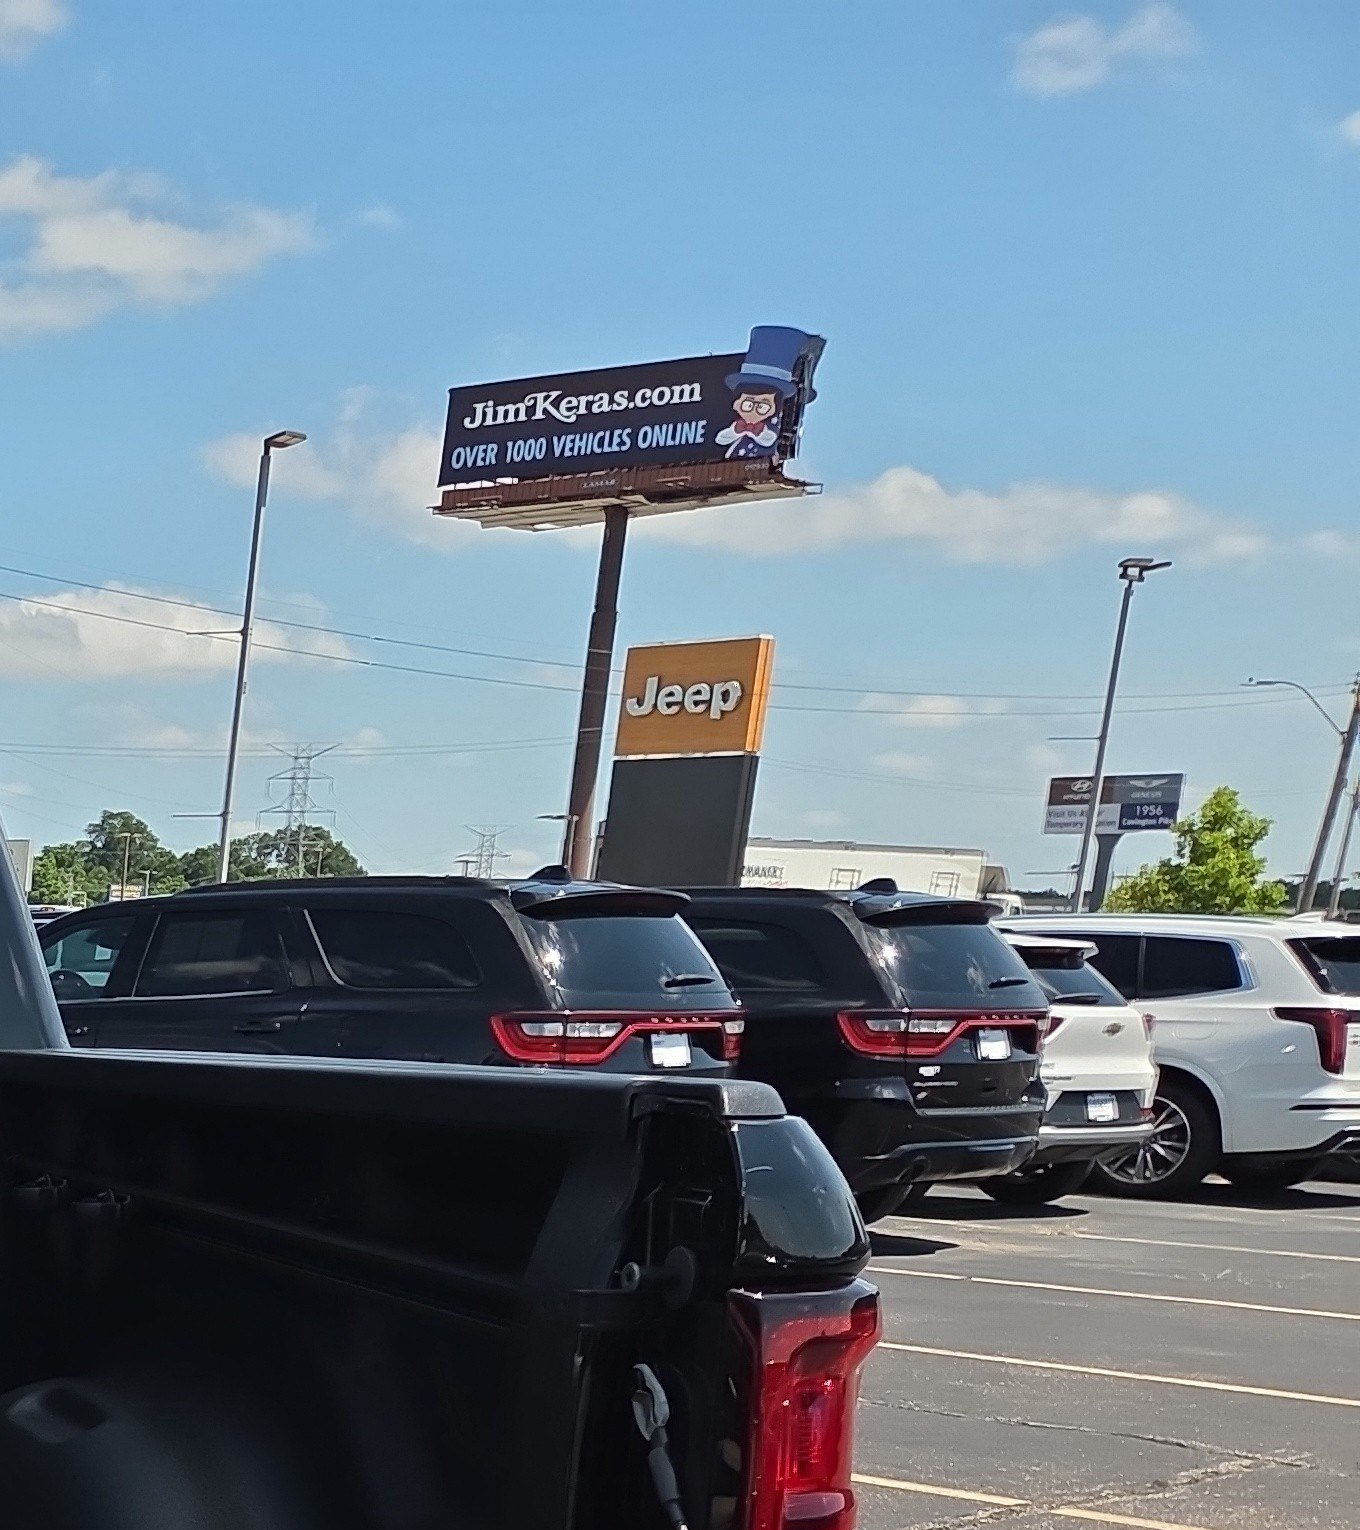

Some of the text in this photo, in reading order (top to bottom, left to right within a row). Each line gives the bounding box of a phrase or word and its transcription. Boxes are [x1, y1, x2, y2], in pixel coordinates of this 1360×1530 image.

[463, 382, 703, 429] JimKeras.com
[451, 419, 708, 470] OVER 1000 VEHICLES ONLINE
[626, 675, 743, 720] Jeep
[1135, 804, 1164, 817] 1956
